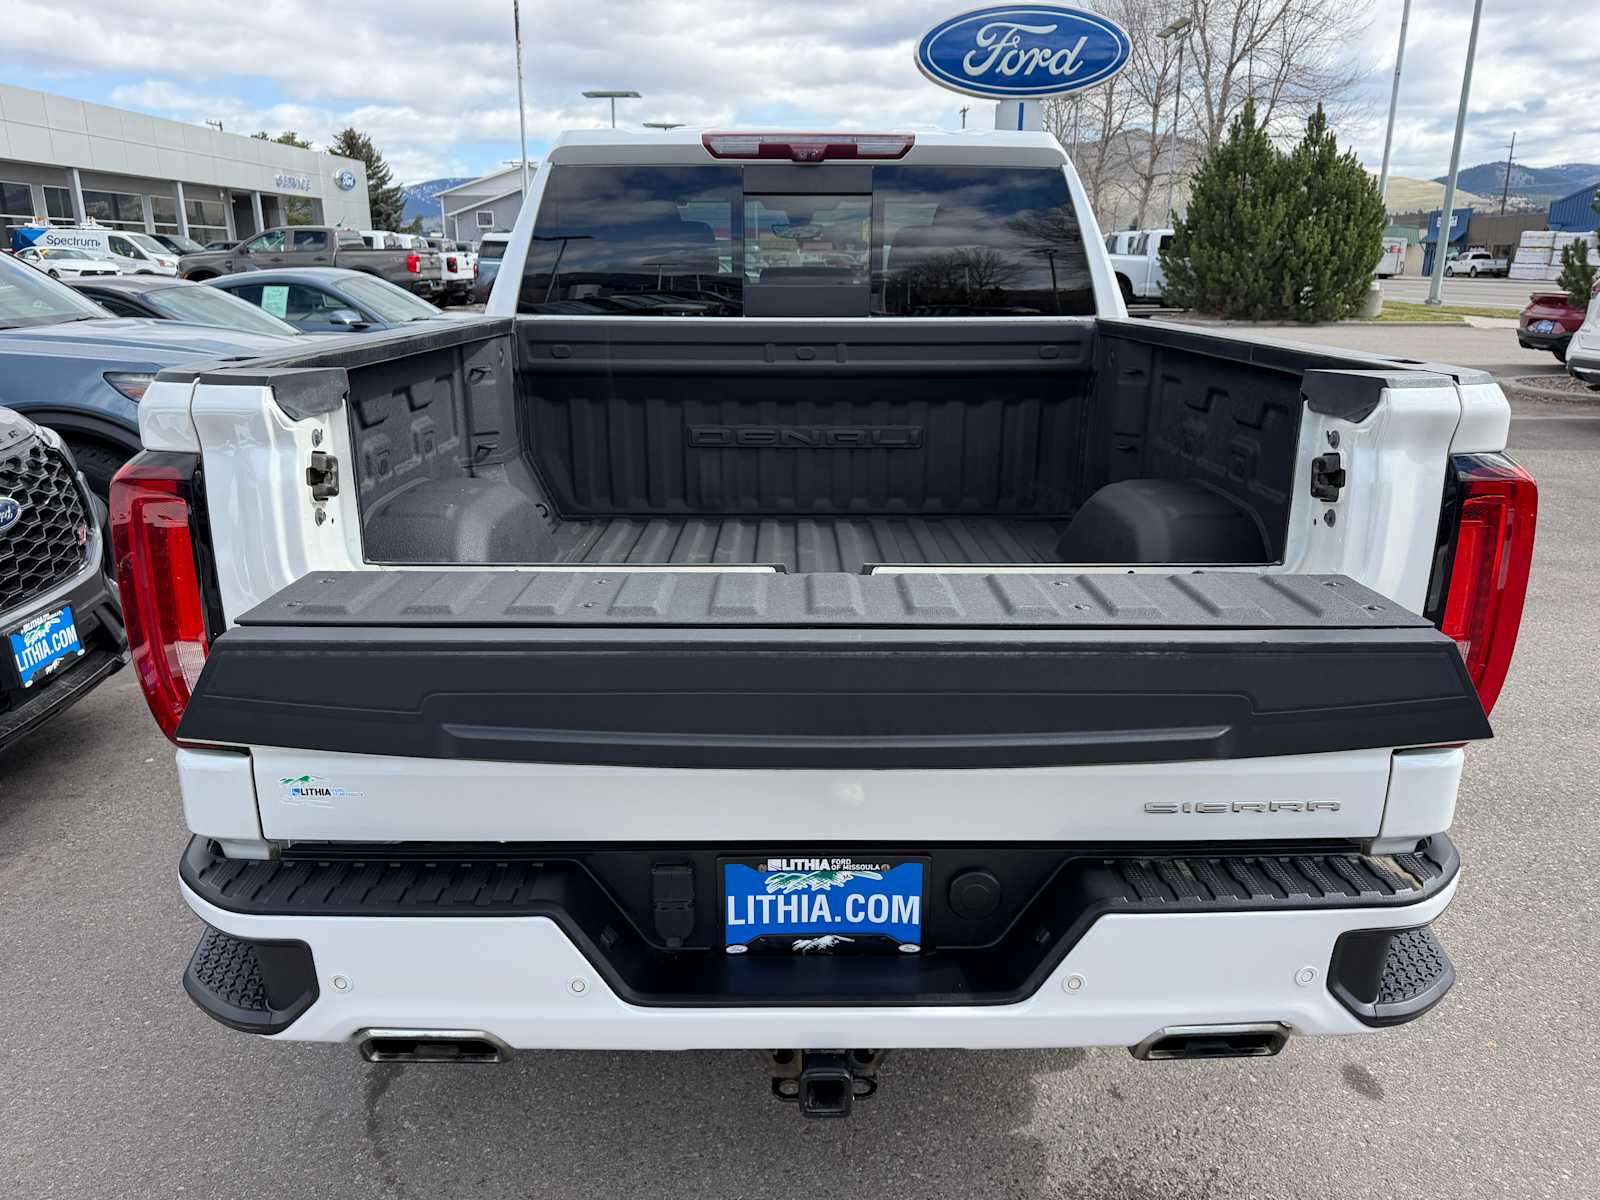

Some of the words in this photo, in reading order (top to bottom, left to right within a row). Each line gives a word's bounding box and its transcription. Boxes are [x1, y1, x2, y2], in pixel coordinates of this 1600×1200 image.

[962, 22, 1088, 76] Ford
[46, 234, 98, 246] Spectrum
[691, 429, 920, 446] DENALI
[15, 624, 78, 672] LITHIA.COM
[300, 788, 332, 796] LITHIA
[1144, 801, 1340, 813] SIERRA
[782, 859, 831, 871] LITHIA
[728, 894, 920, 925] LITHIA.COM
